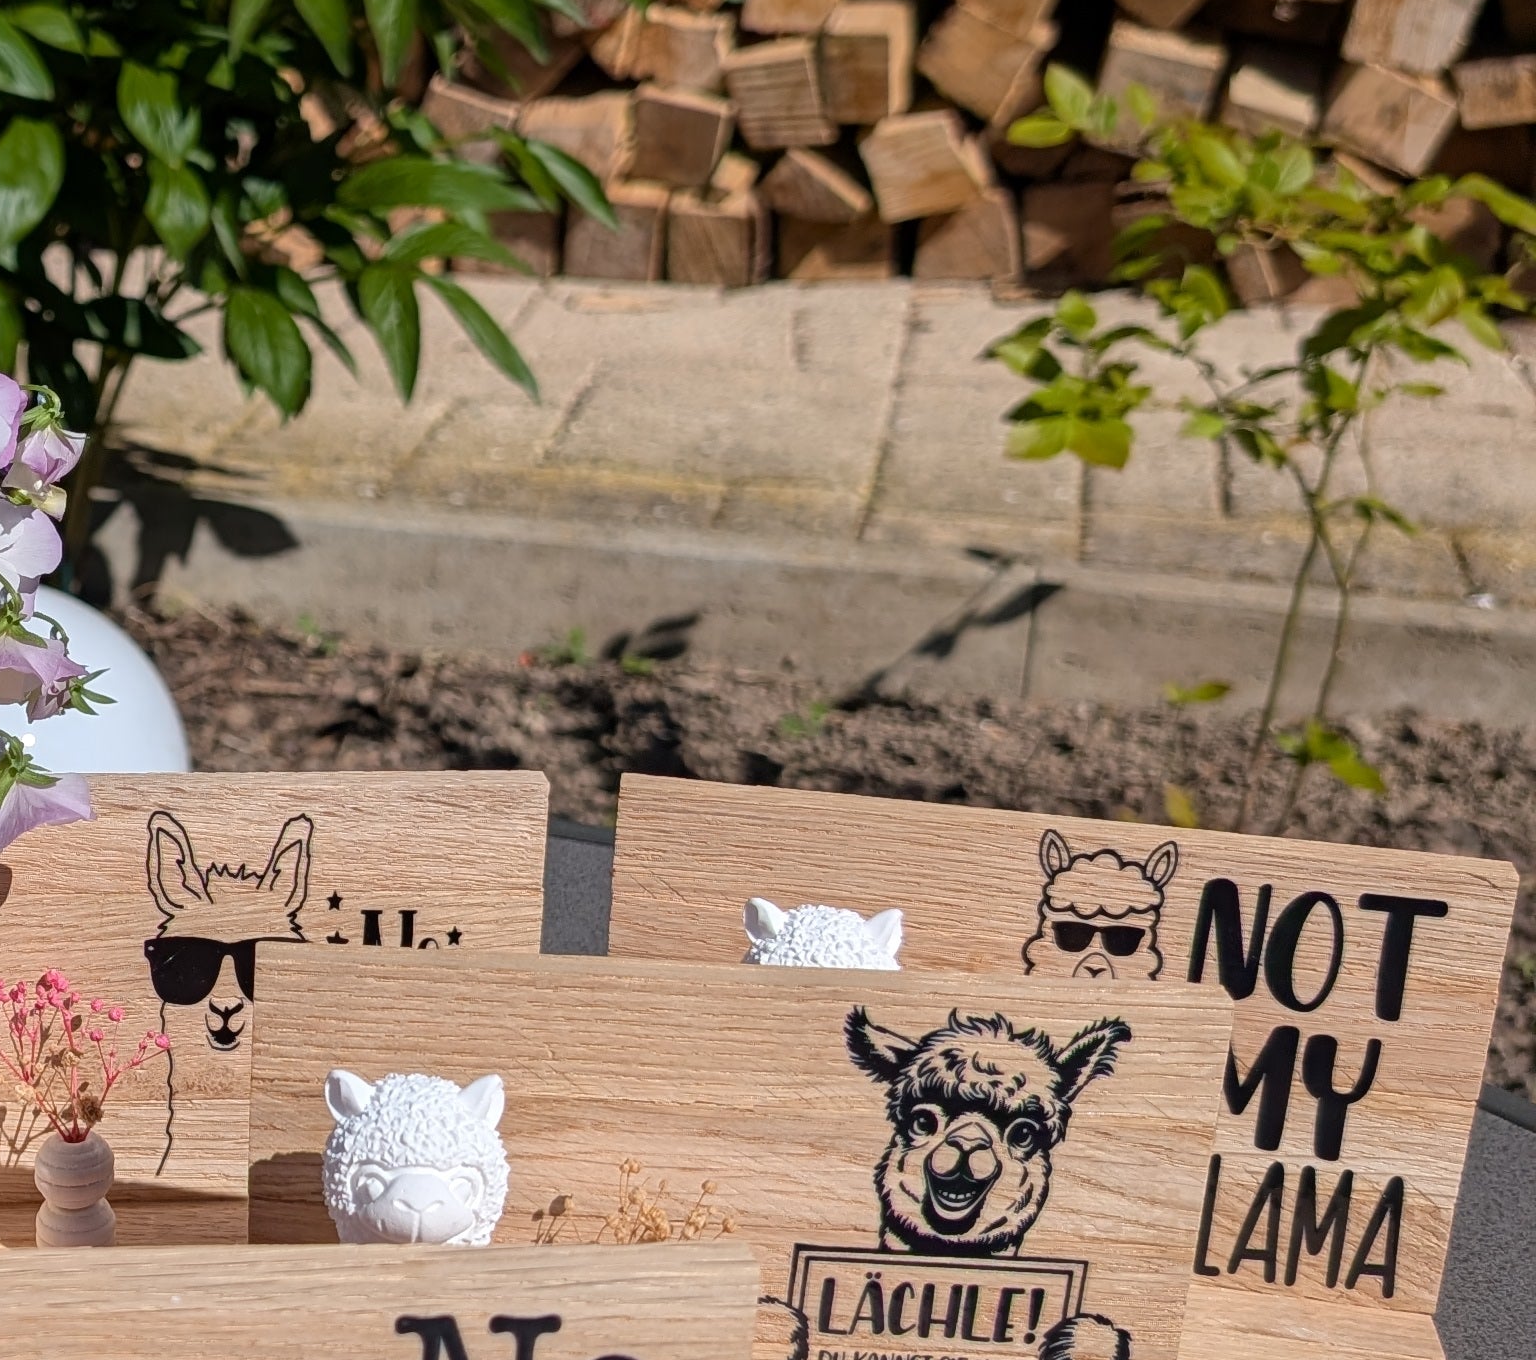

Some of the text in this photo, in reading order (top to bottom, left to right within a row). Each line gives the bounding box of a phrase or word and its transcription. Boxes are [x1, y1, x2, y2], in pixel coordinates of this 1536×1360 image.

[1187, 878, 1449, 1022] NOT
[1223, 1025, 1382, 1161] MY
[1193, 1154, 1404, 1299] LAMA
[817, 1271, 1046, 1345] LÄCHLE!
